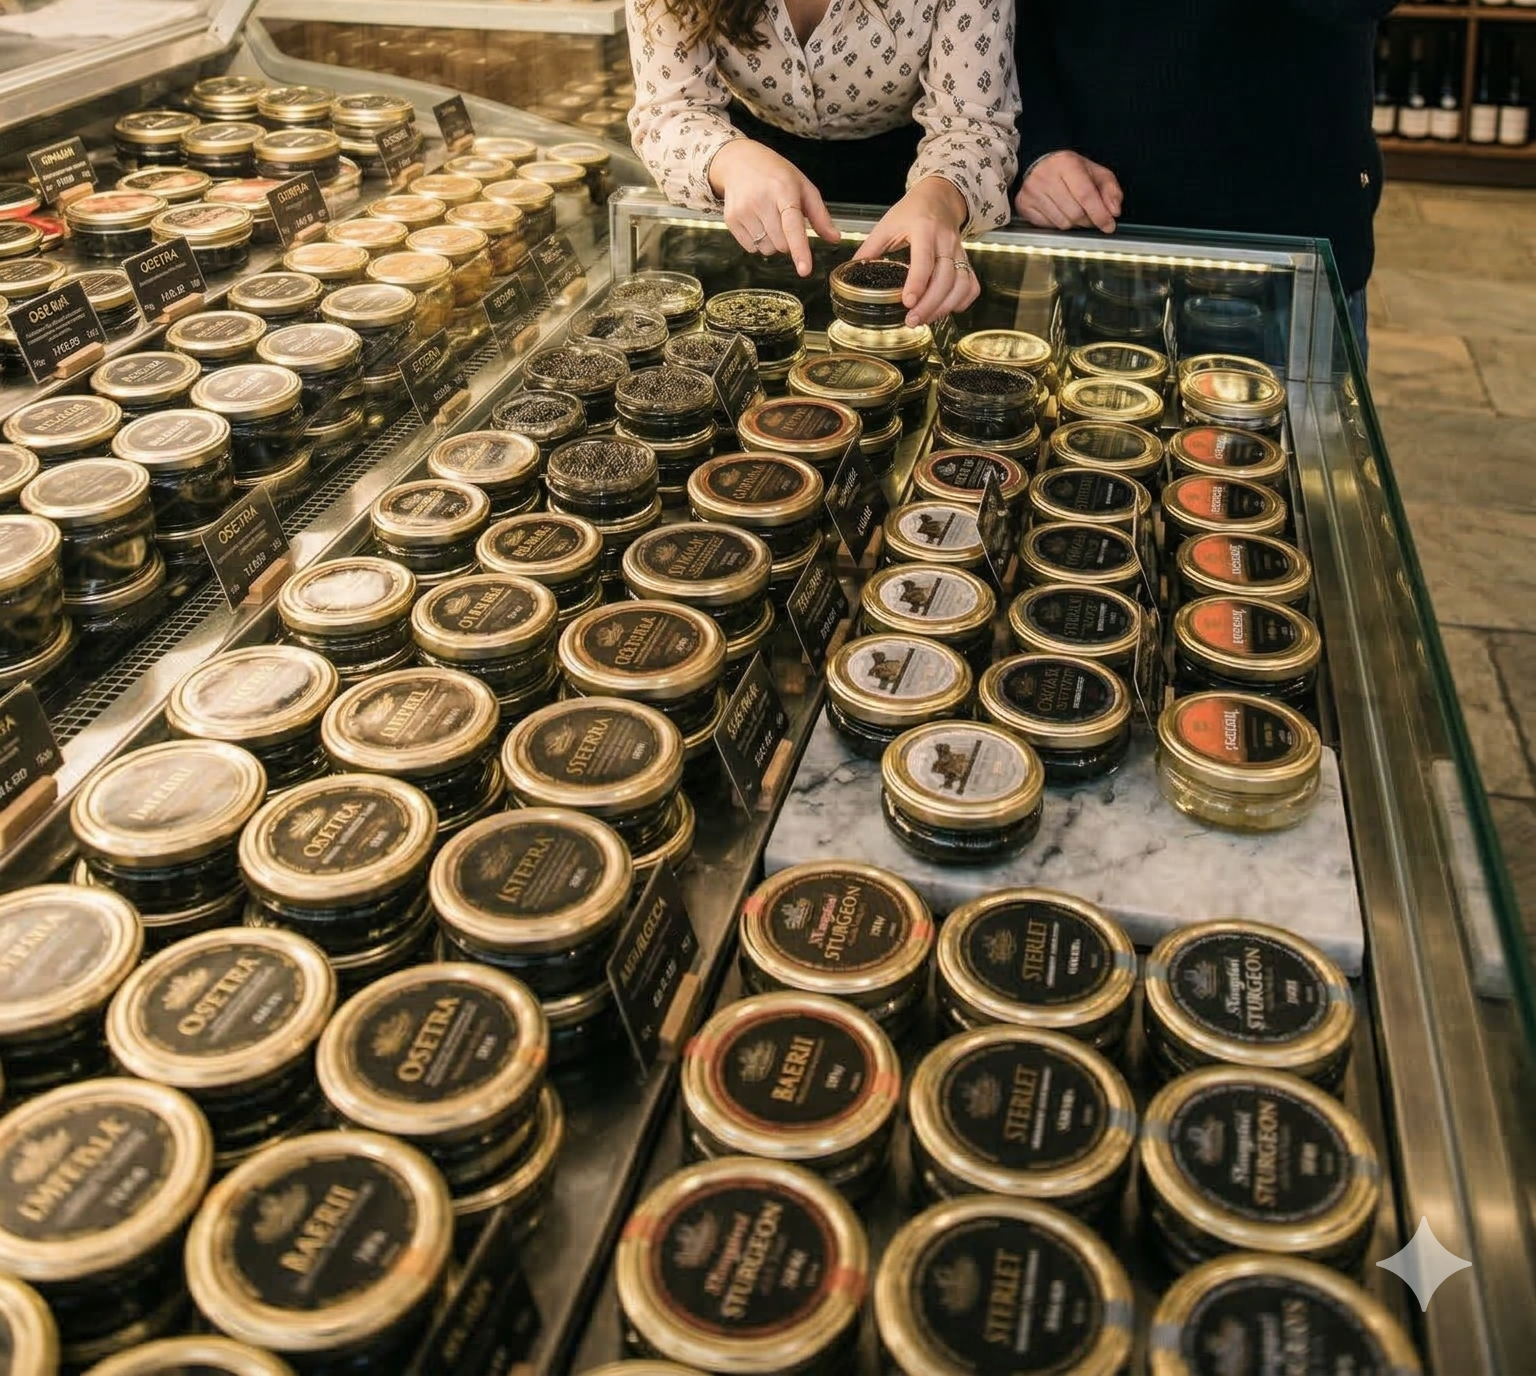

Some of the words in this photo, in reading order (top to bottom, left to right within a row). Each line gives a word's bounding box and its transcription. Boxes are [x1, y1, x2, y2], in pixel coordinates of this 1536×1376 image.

[303, 800, 362, 857] OSETRA
[823, 885, 861, 962] STURGEON
[1021, 918, 1048, 983] STERLET
[178, 955, 262, 1036] OSETRA
[1246, 946, 1262, 1031] STURGEON
[399, 996, 460, 1083] OSETRA
[1004, 1064, 1039, 1145] STERLET
[1253, 1099, 1281, 1208] STURGEON
[721, 1200, 785, 1320] STURGEON
[983, 1248, 1022, 1346] STERLET
